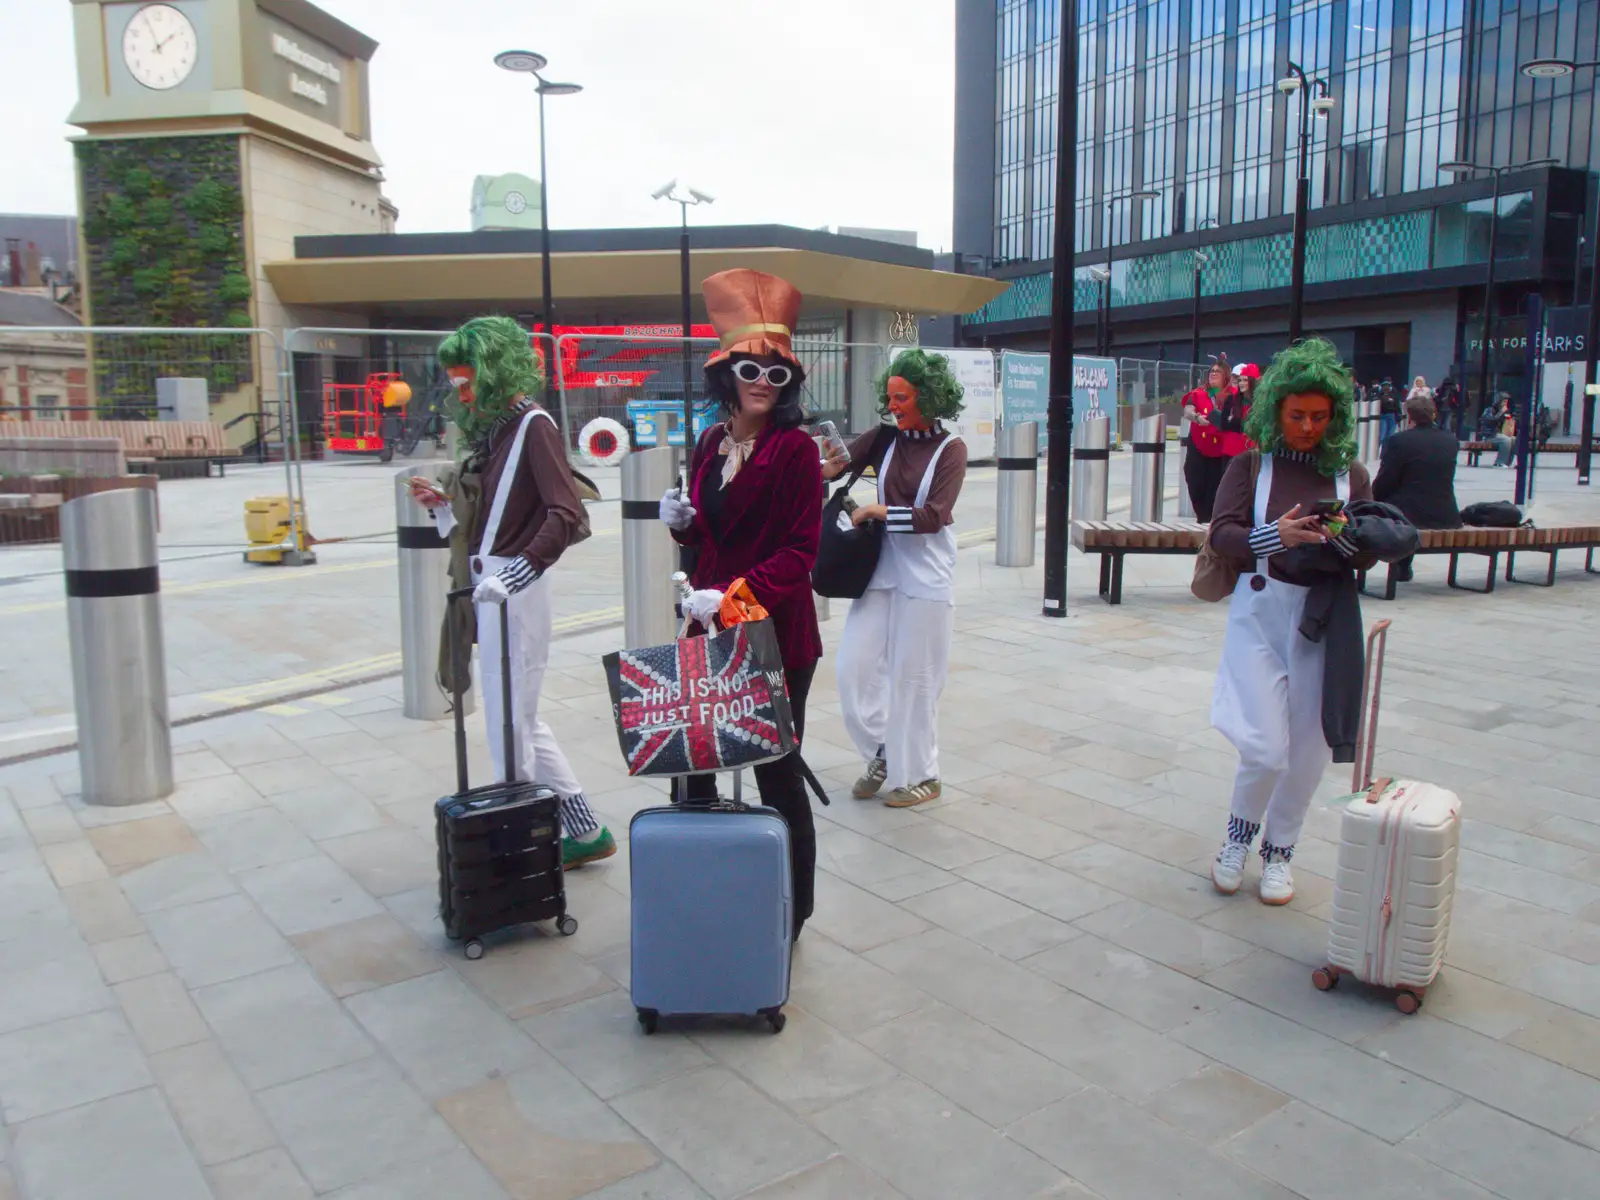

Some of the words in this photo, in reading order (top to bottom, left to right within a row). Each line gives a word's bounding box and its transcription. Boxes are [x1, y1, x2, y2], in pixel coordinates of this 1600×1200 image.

[642, 681, 682, 707] THIS
[689, 677, 710, 698] IS
[717, 669, 751, 697] NOT
[639, 705, 690, 725] JUST
[699, 695, 755, 725] FOOD
